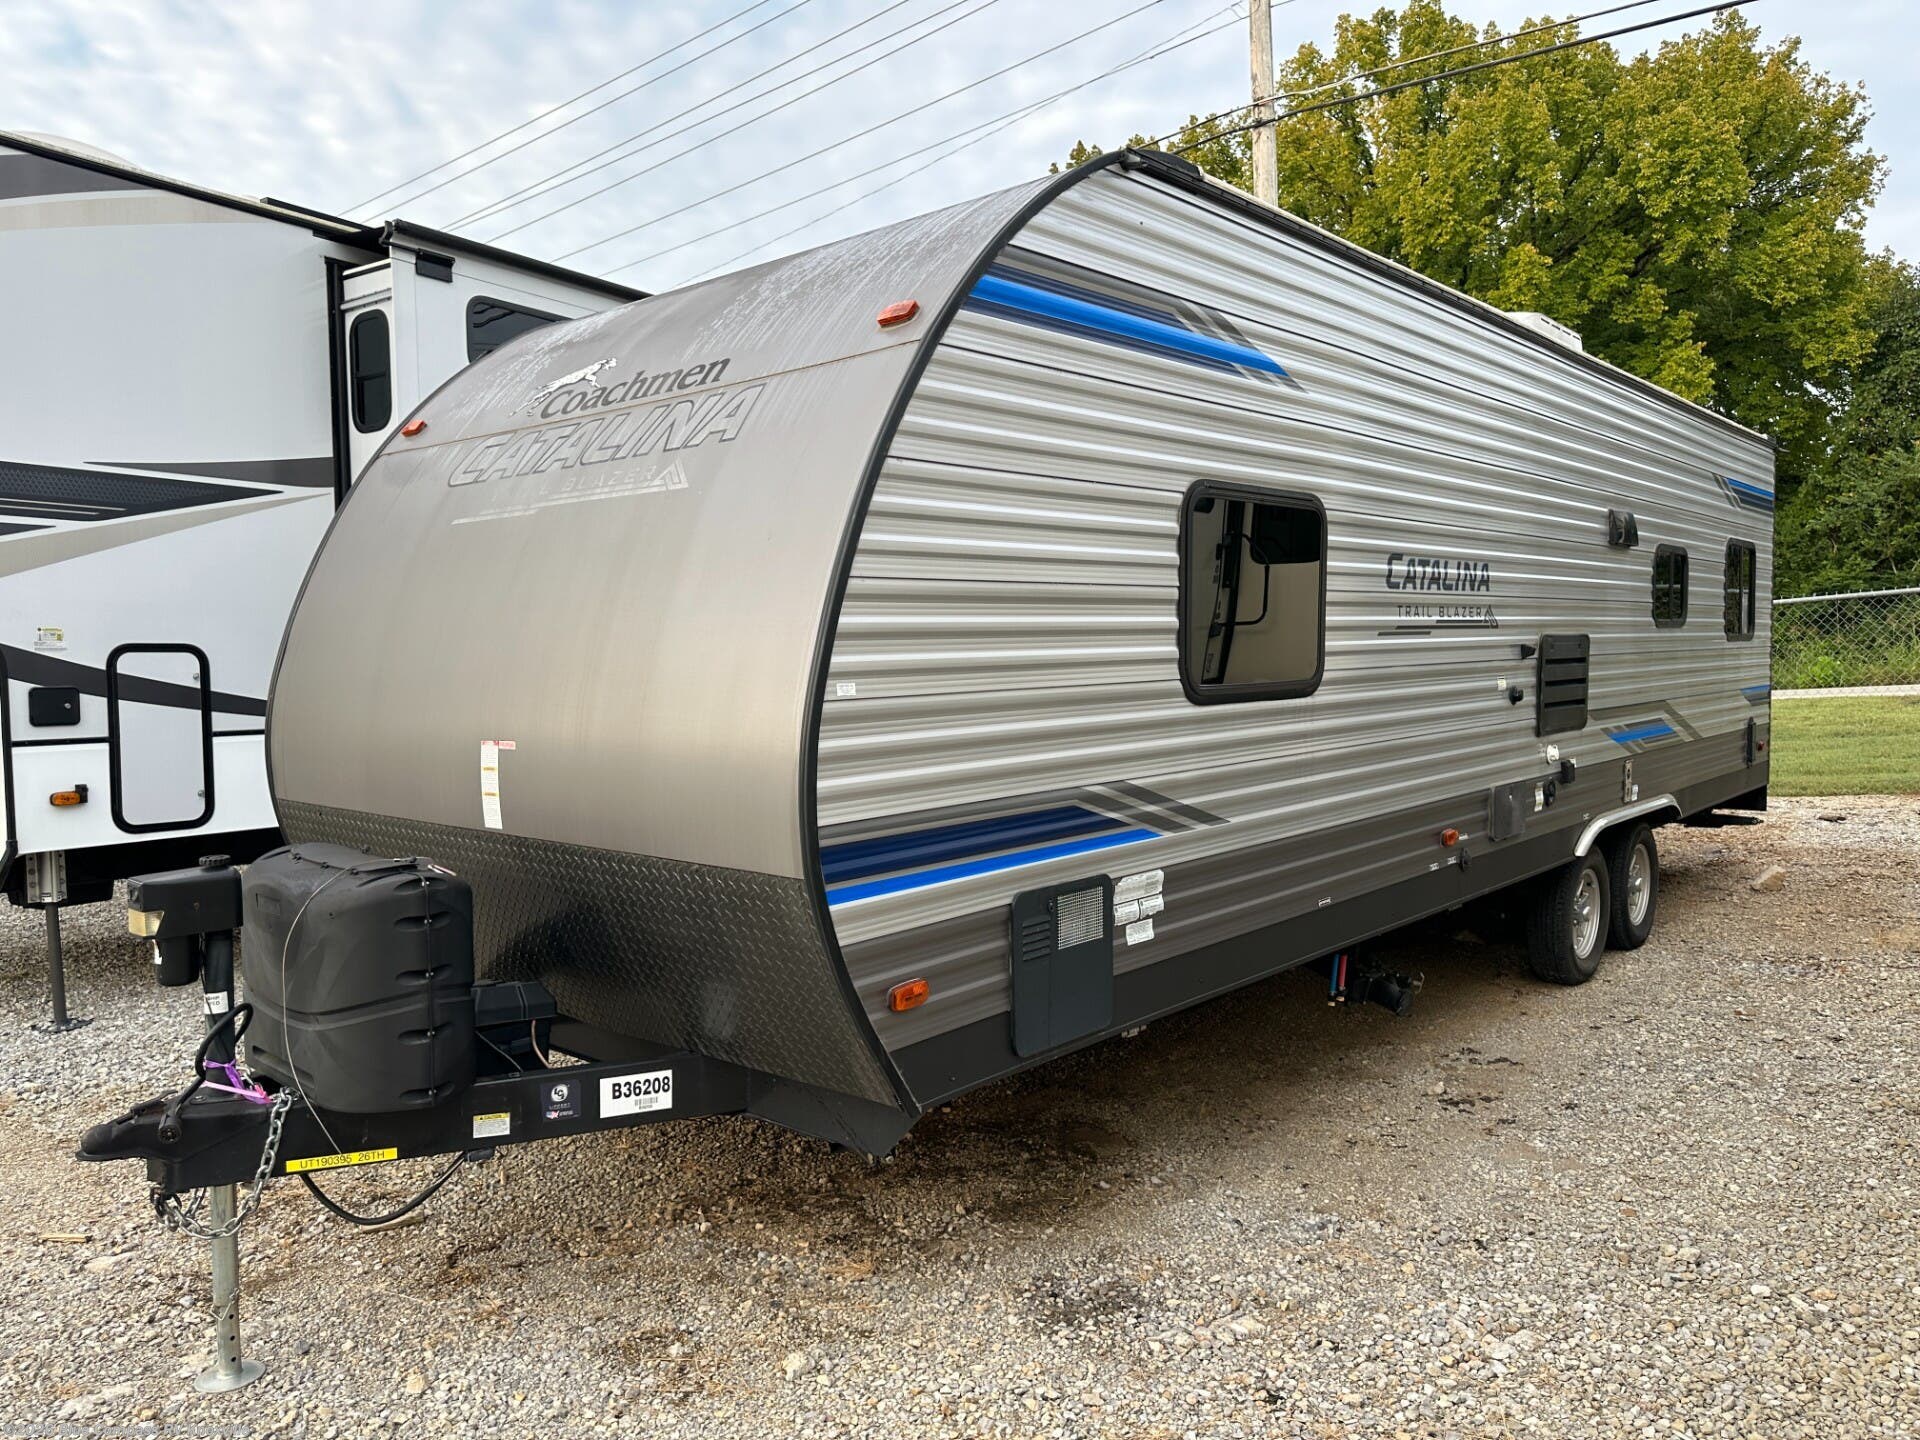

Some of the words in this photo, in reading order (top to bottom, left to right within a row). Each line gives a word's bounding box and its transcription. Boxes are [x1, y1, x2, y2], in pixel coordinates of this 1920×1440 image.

[541, 357, 731, 419] Coachmen
[448, 382, 767, 488] CATALINA
[1385, 552, 1490, 592] CATALINA
[1397, 605, 1433, 618] TRAIL
[1439, 606, 1482, 618] BLAZER
[611, 1075, 671, 1100] B36208
[300, 1154, 353, 1169] UT190395
[358, 1150, 385, 1162] 26TH
